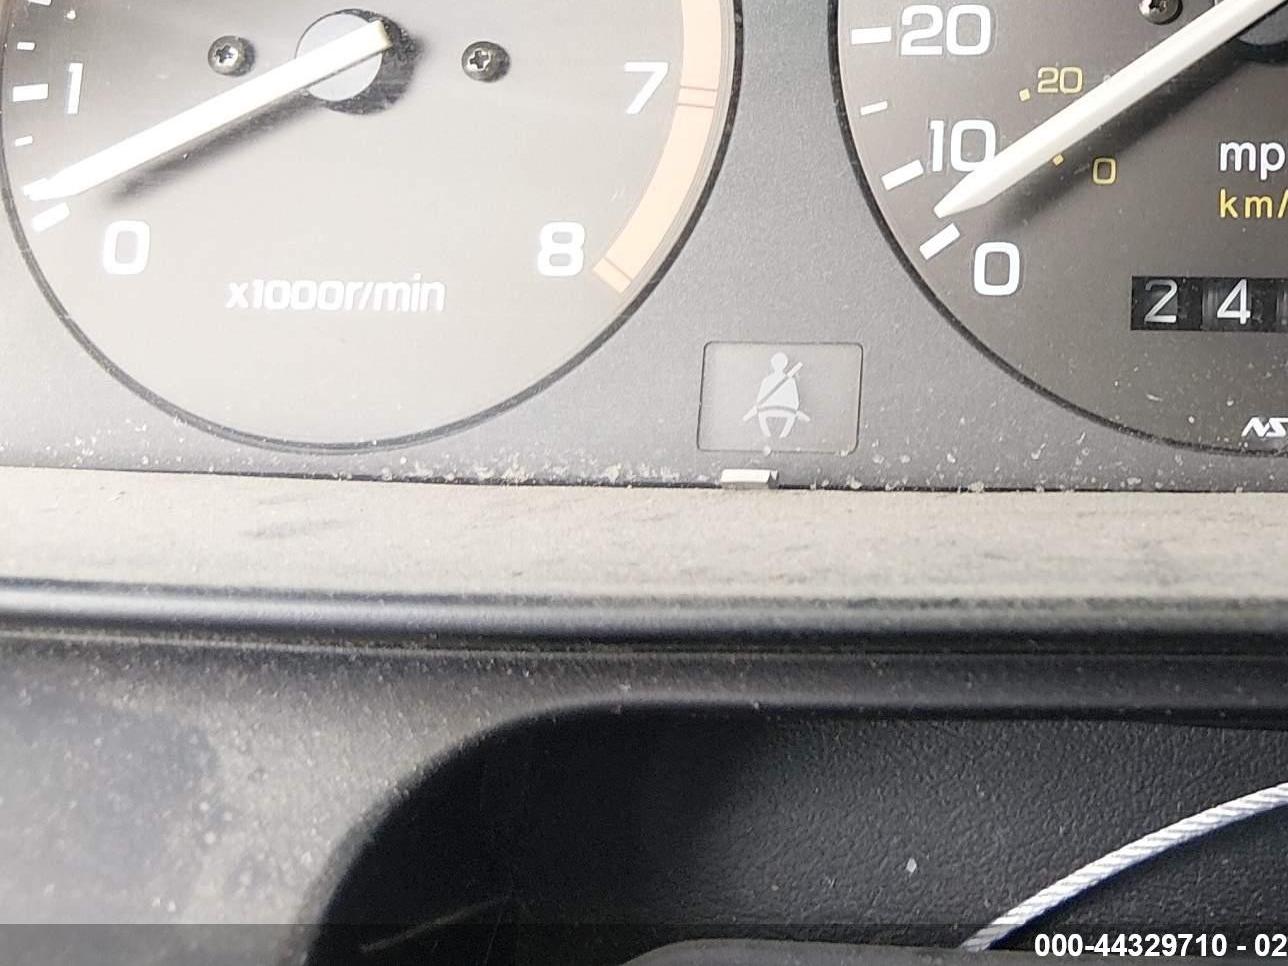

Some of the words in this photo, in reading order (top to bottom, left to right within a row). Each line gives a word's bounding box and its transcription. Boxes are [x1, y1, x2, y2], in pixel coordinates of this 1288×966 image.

[900, 4, 992, 56] 20
[66, 61, 84, 115] 1
[623, 61, 669, 115] 7
[1037, 66, 1083, 94] 20
[928, 118, 997, 173] 10
[1092, 157, 1117, 185] 0
[101, 220, 151, 274] 0
[537, 221, 586, 277] 8
[973, 240, 1021, 296] 0
